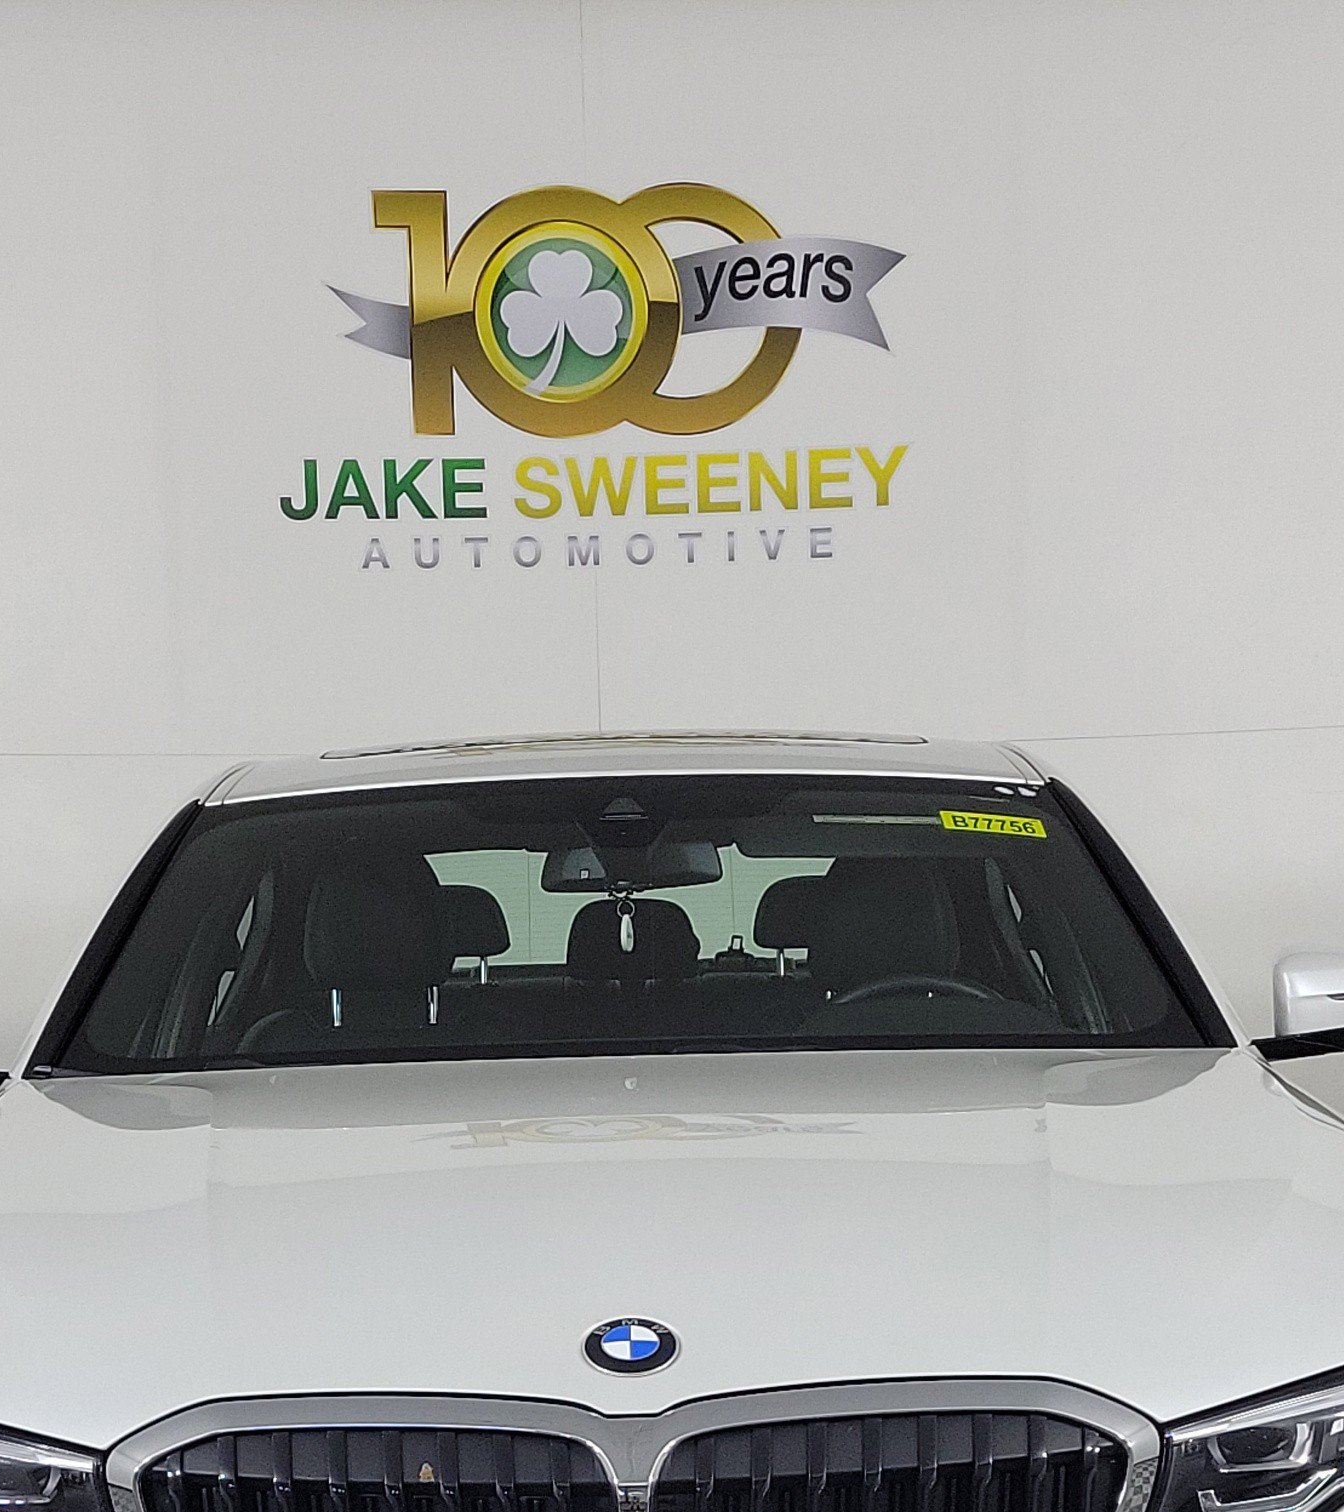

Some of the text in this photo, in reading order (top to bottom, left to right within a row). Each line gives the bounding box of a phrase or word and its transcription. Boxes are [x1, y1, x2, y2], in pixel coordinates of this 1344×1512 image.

[371, 181, 853, 438] 100 years
[279, 445, 909, 521] JAKE SWEENEY
[361, 527, 834, 570] AUTOMOTIVE
[952, 815, 1036, 834] B77756
